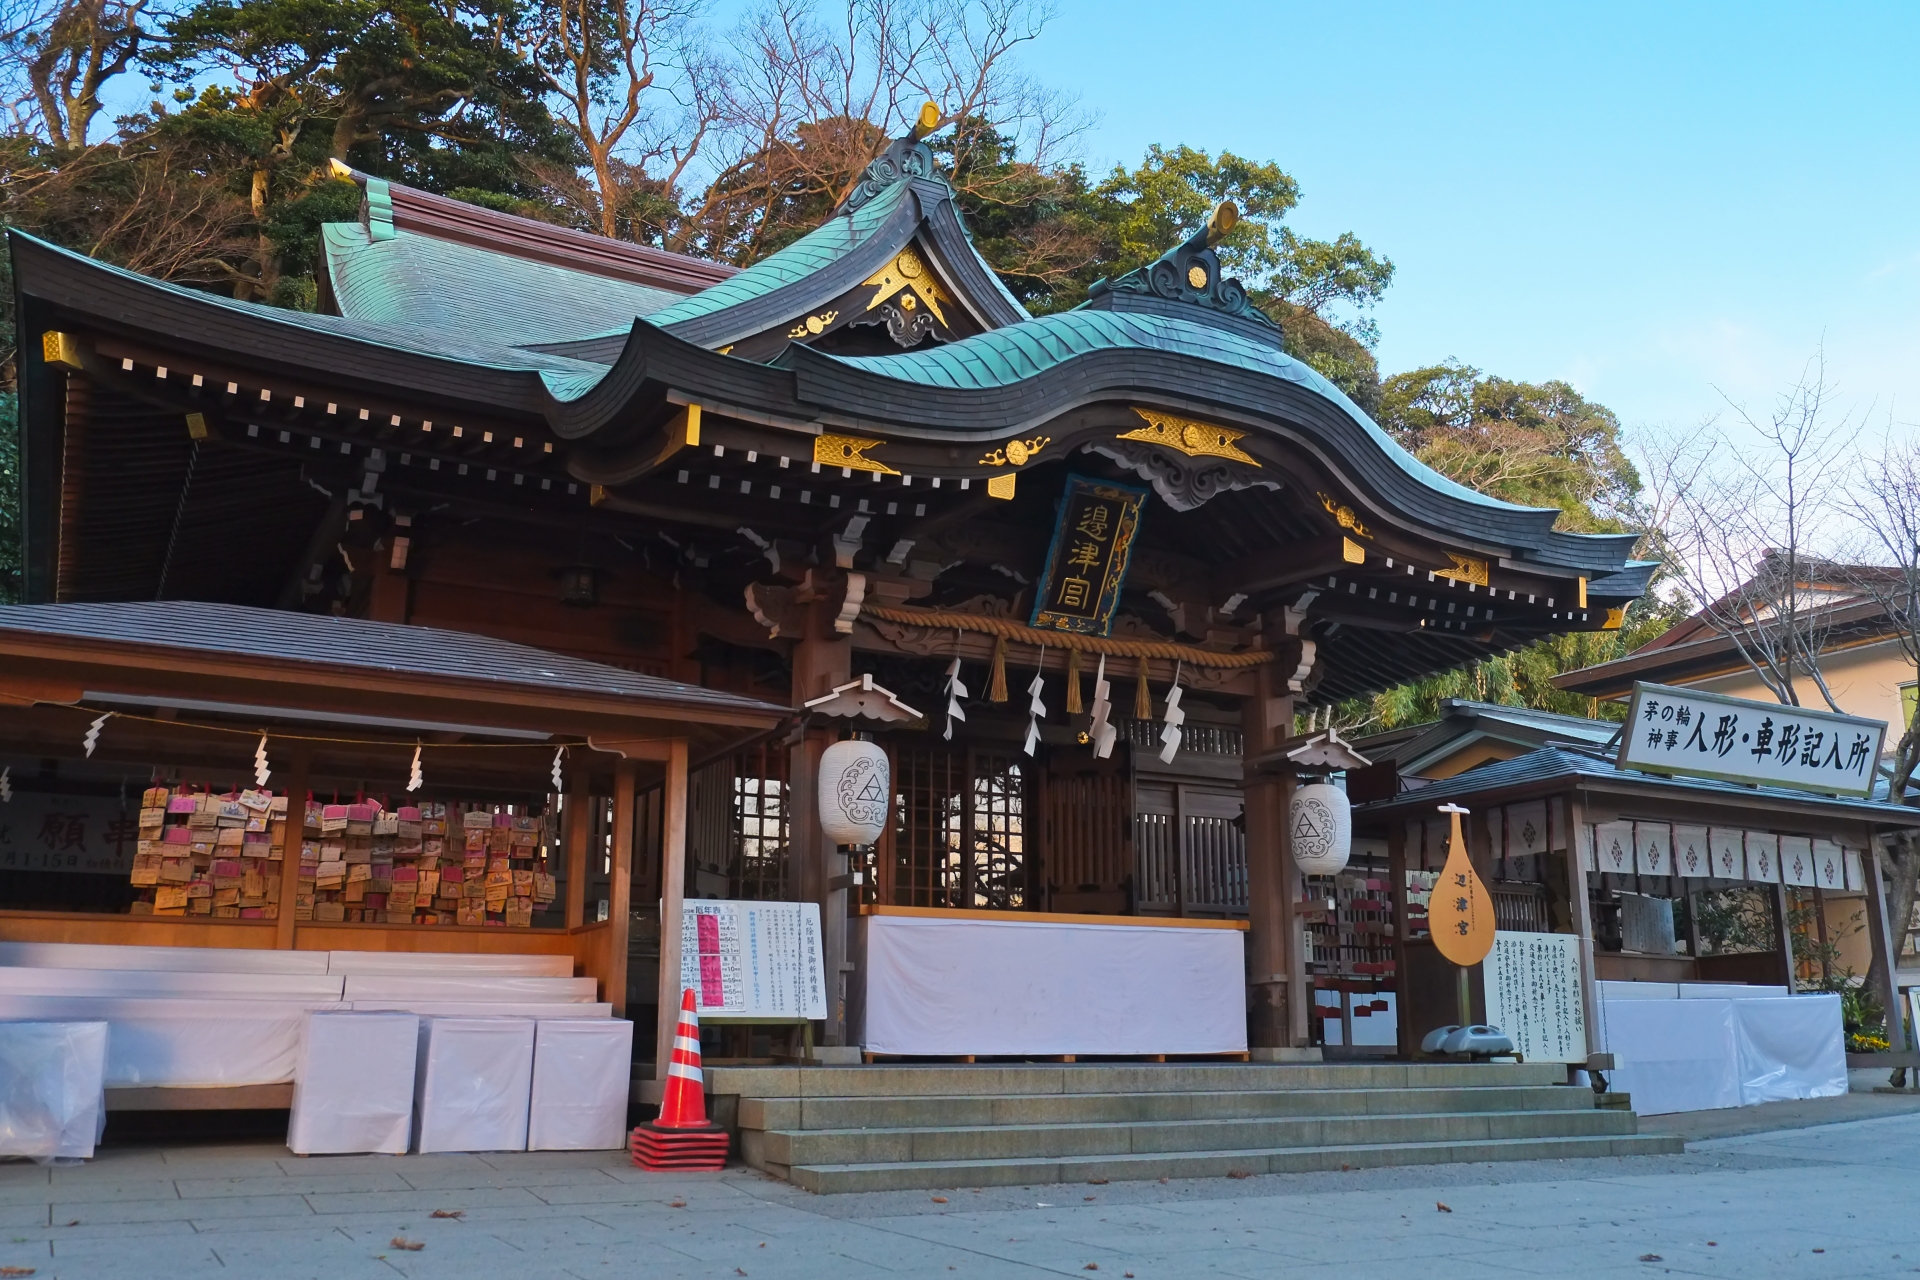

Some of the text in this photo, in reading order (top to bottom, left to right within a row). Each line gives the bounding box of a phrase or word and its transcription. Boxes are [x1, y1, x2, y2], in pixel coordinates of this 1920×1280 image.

[1643, 700, 1691, 727] 茅の輪
[1647, 728, 1679, 751] 神事
[1683, 712, 1871, 777] 人形・車形記入所
[696, 905, 721, 915] 厄年表
[1454, 873, 1470, 936] 辺津宮
[805, 917, 819, 1003] 厄除開運御祈祷案内
[1571, 957, 1583, 1032] 人形・車形のお祓い
